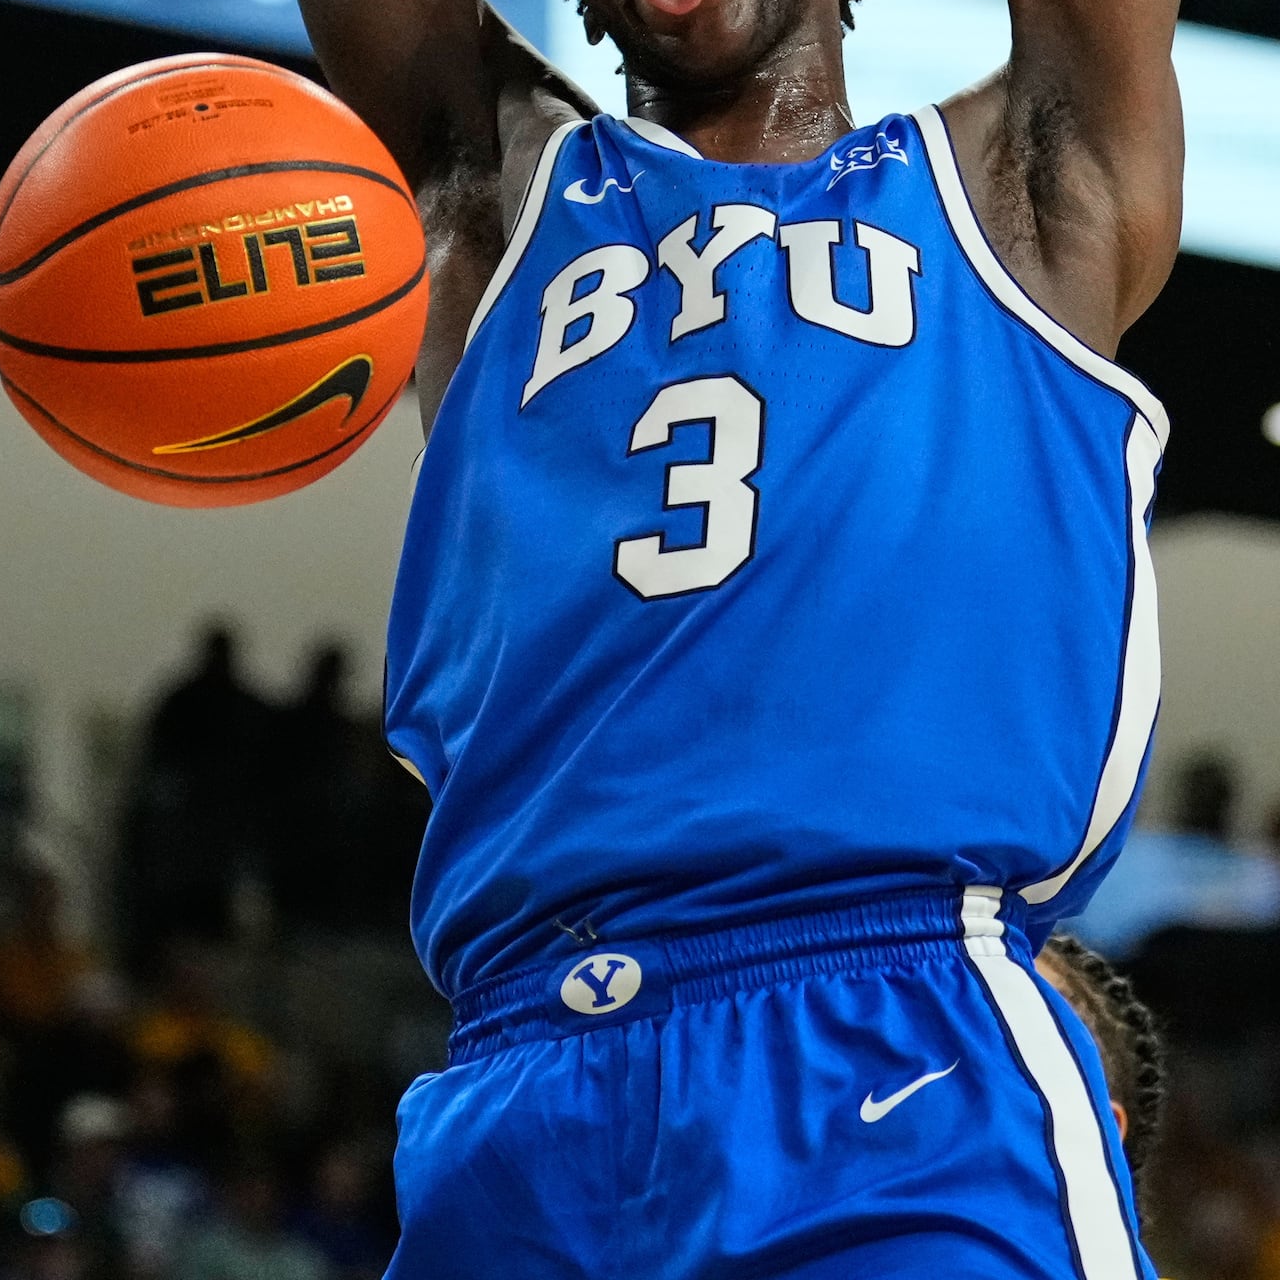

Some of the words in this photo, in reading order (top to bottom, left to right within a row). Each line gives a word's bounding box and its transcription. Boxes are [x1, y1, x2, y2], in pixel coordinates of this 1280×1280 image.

[131, 214, 366, 318] ELITE
[519, 202, 922, 414] BYU
[614, 373, 766, 602] 3
